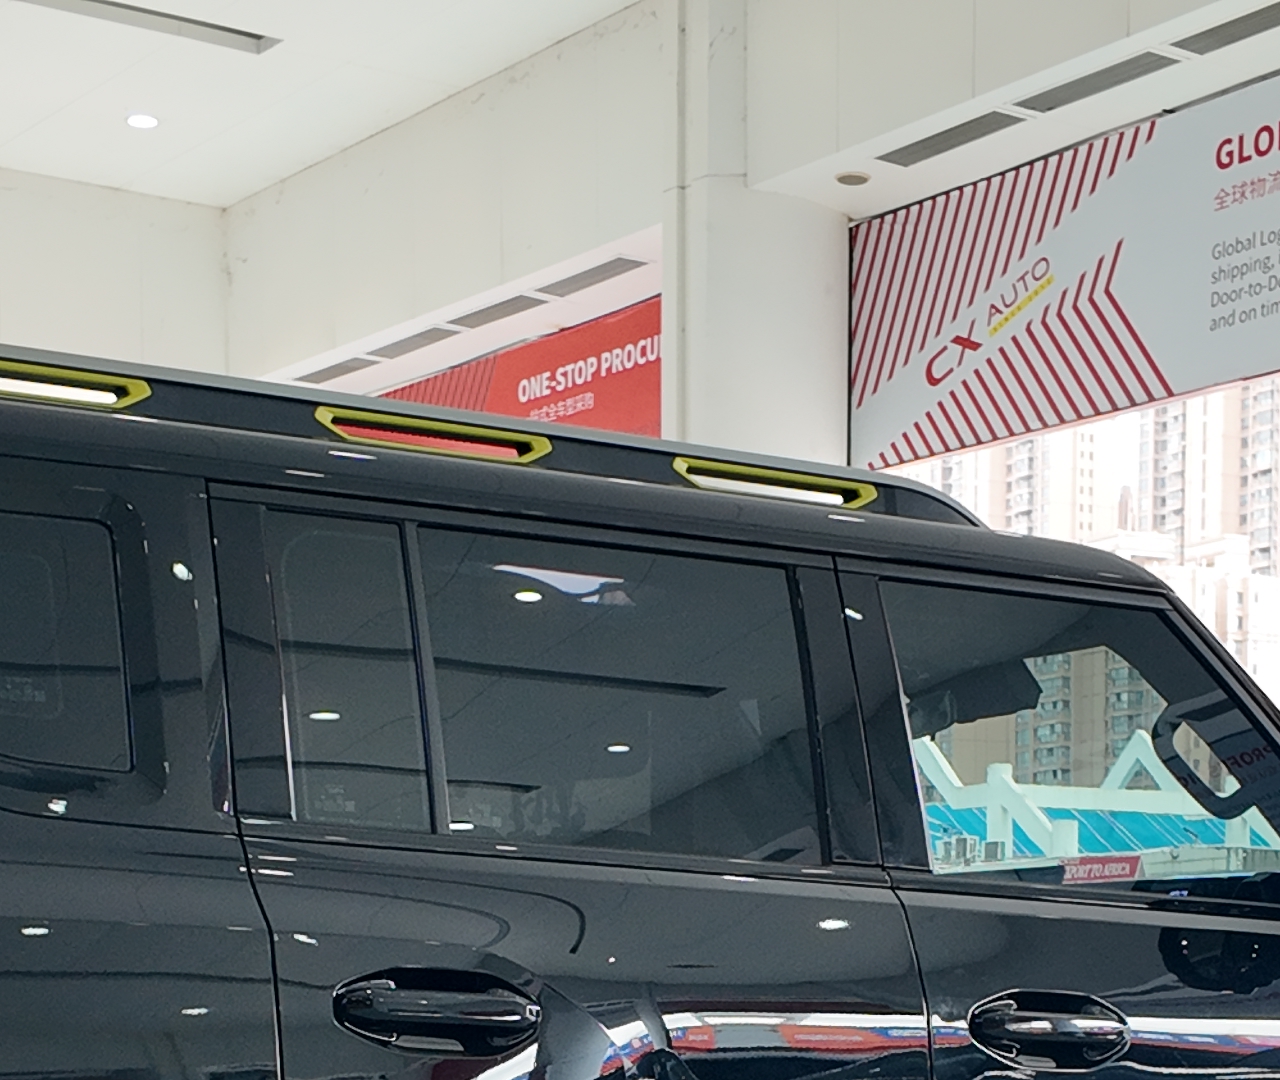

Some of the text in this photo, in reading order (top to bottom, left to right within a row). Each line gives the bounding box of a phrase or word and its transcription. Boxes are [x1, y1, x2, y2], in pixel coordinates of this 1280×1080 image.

[1211, 232, 1256, 260] Global
[1211, 257, 1275, 285] shipping,
[925, 317, 983, 386] CX
[987, 257, 1050, 327] AUTO
[1210, 311, 1235, 332] and
[1239, 306, 1256, 323] on
[517, 334, 662, 403] ONE-STOP PROCU
